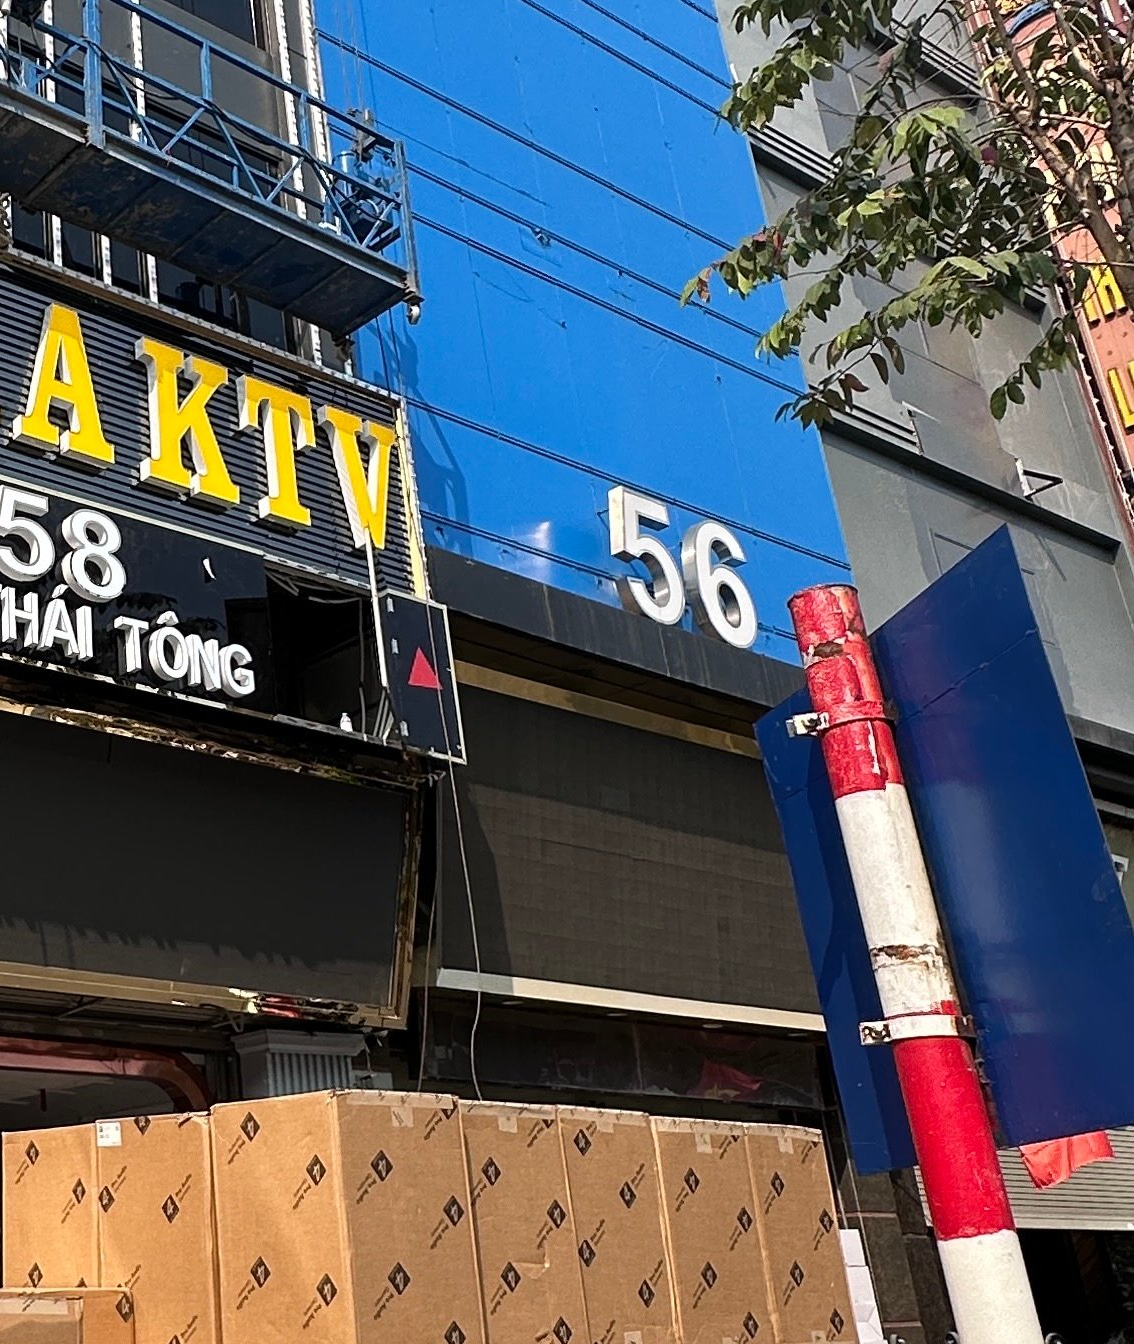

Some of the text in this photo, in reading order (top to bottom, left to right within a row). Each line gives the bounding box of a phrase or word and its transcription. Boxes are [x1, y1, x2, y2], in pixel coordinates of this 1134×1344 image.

[133, 335, 397, 552] KTV
[608, 485, 758, 648] 56
[108, 610, 255, 699] TÔNG
